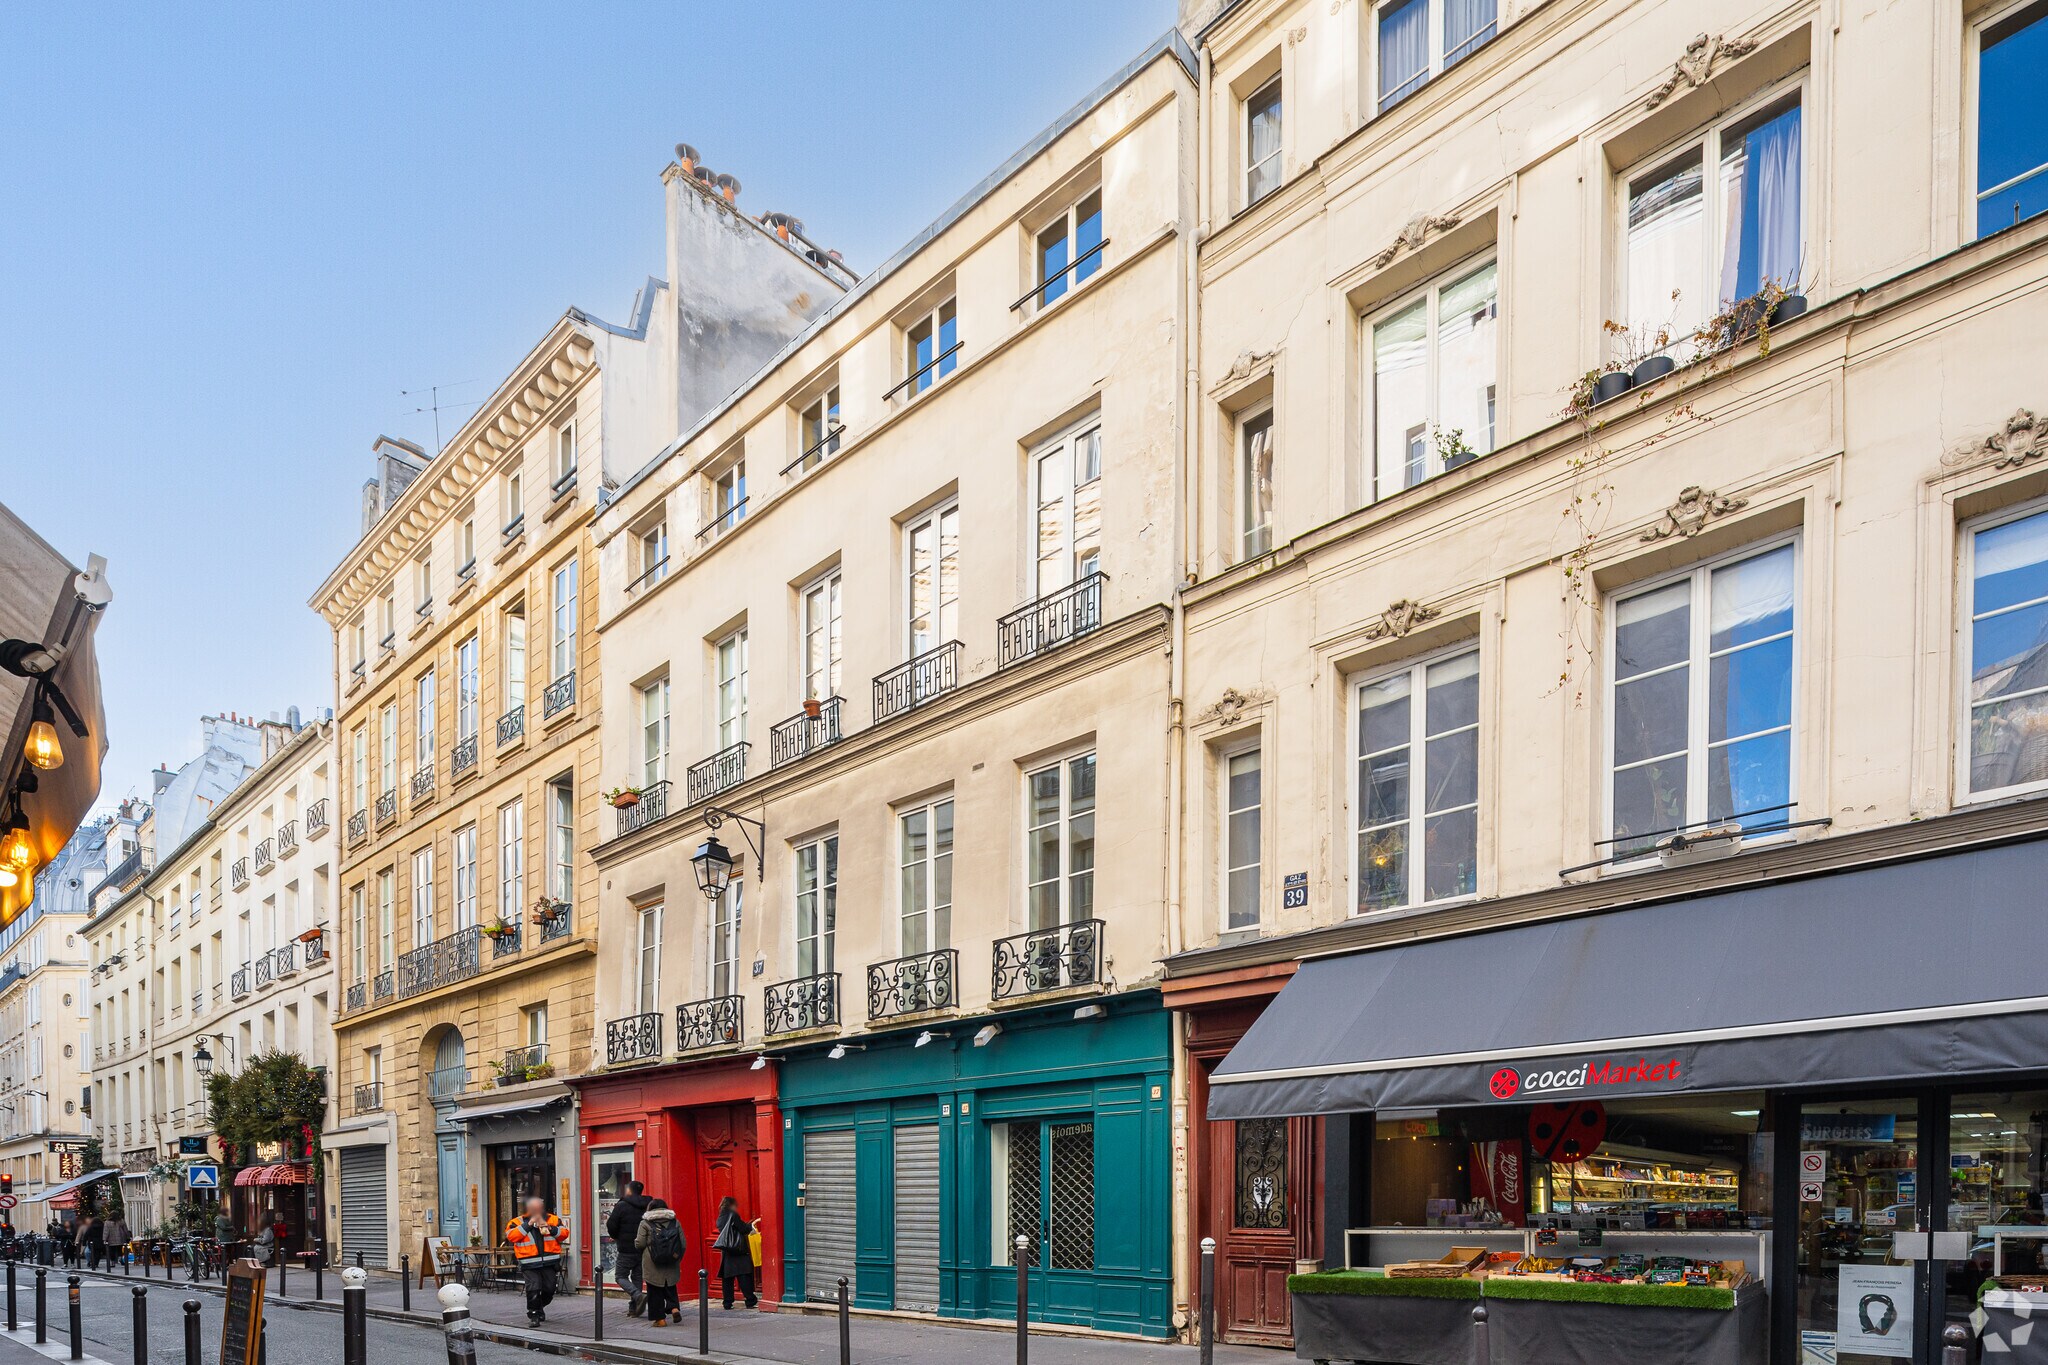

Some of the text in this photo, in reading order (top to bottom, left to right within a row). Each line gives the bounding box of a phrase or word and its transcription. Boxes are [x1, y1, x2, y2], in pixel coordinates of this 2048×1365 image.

[1287, 889, 1305, 906] 39
[753, 961, 763, 974] 37
[1524, 1057, 1682, 1090] cocciMarket
[62, 1153, 71, 1174] IZZA
